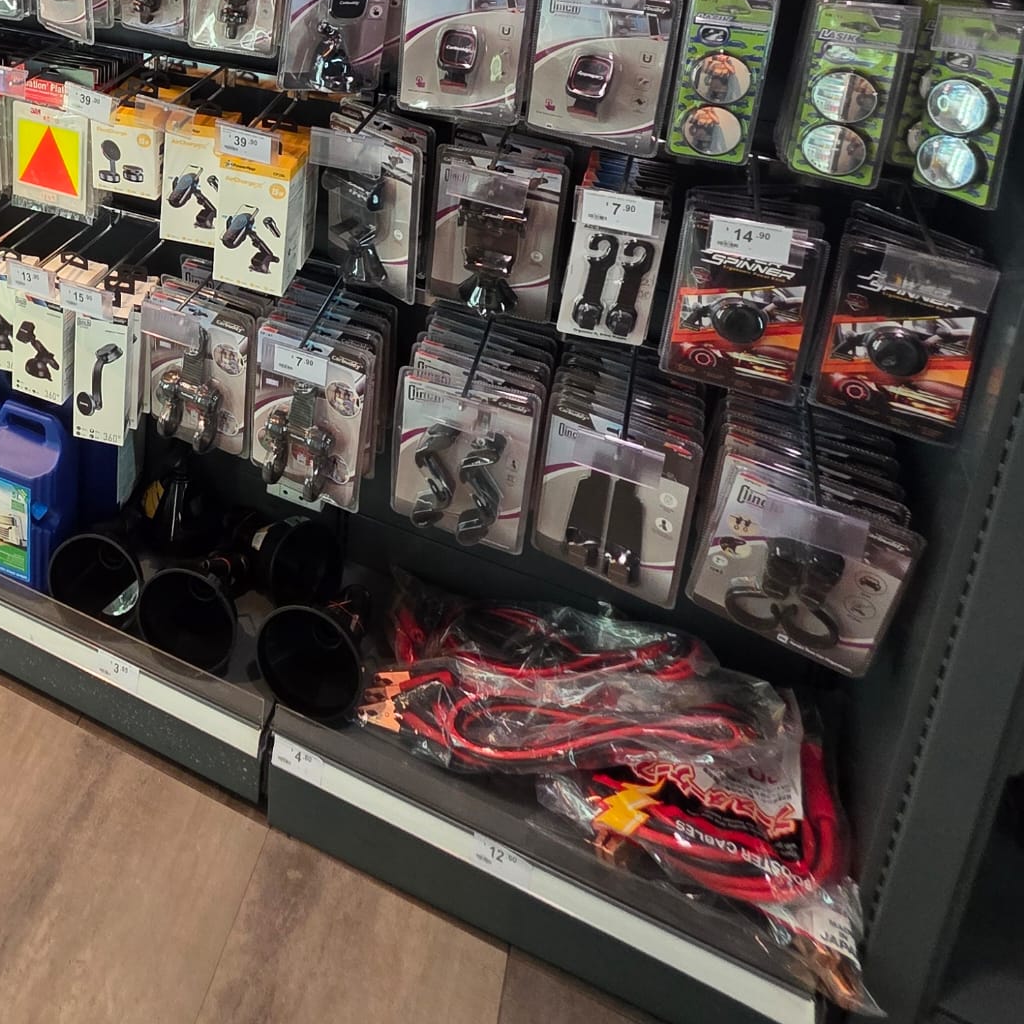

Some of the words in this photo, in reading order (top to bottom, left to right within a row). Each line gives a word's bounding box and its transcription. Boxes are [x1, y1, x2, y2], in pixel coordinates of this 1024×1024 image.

[819, 29, 860, 42] LASIK
[701, 254, 796, 280] SPINNER
[857, 280, 961, 311] SPINNER
[675, 819, 738, 854] CABLES
